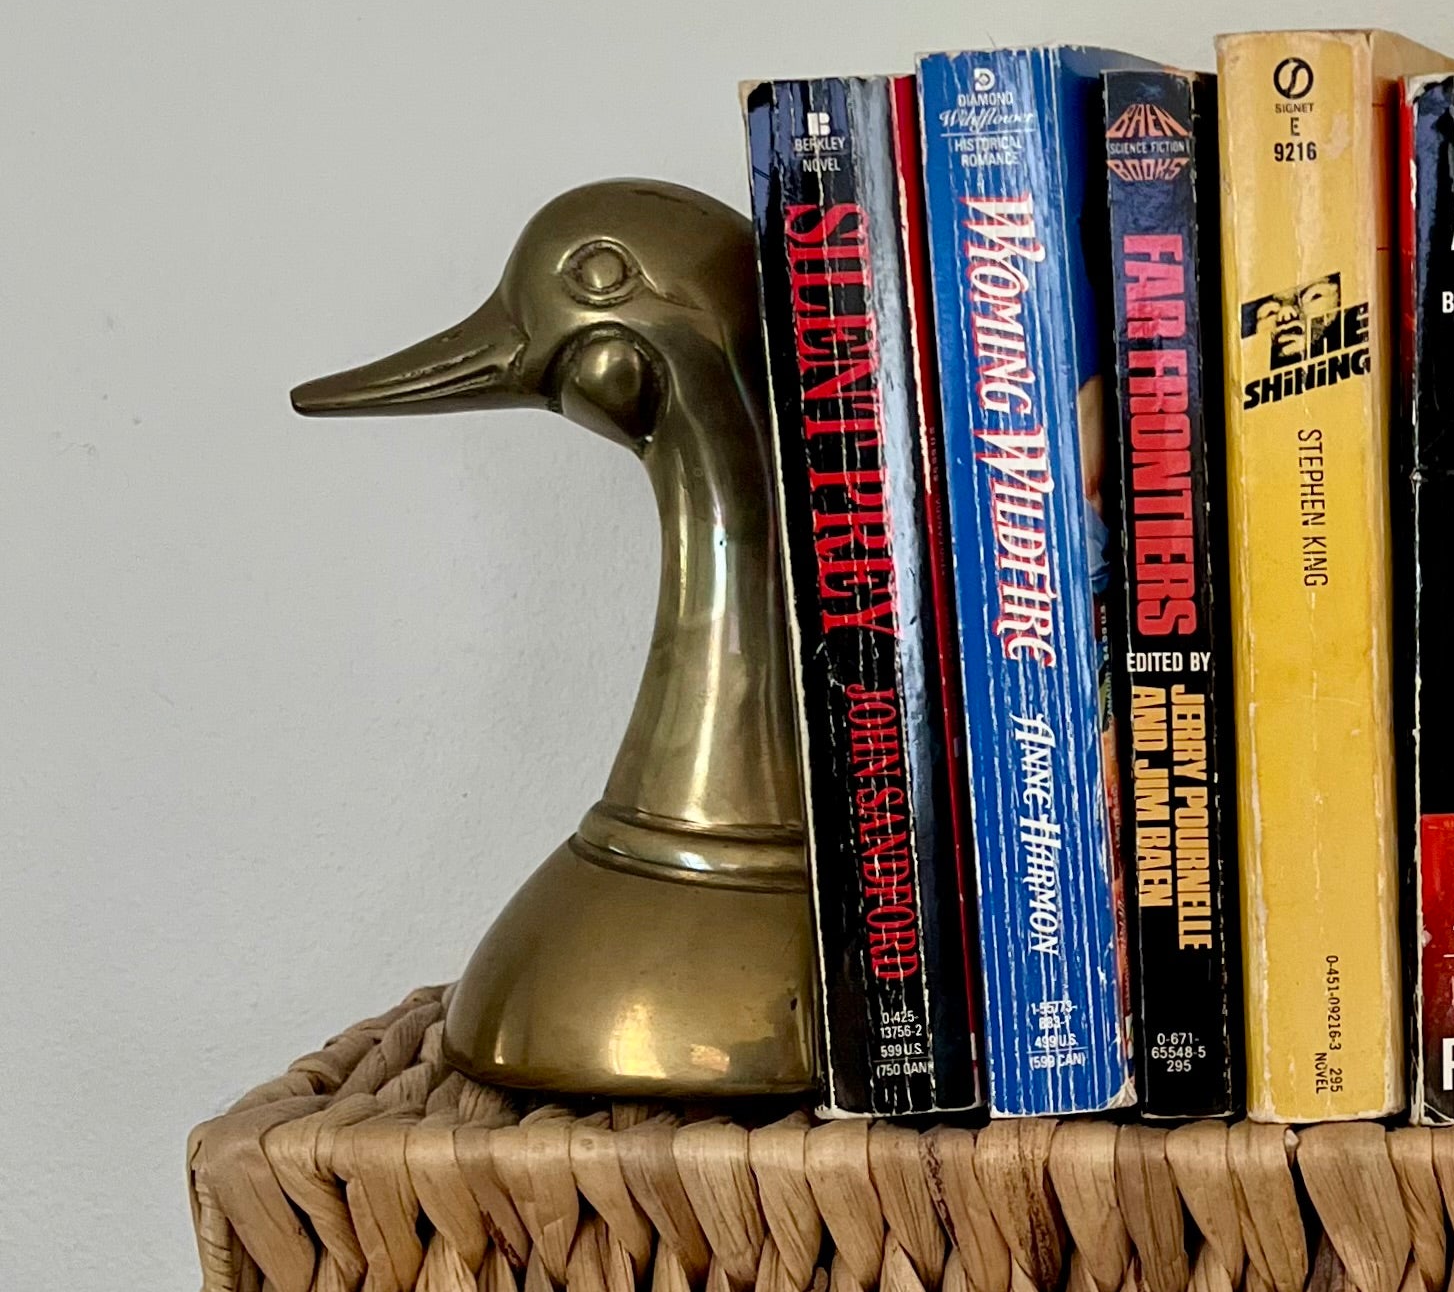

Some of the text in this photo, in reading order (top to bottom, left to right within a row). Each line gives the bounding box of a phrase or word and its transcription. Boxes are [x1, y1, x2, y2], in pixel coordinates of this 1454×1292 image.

[957, 91, 1014, 107] DIAMOND
[1275, 102, 1314, 114] SIGNET
[1105, 104, 1190, 138] BAEN
[1290, 116, 1300, 136] E
[794, 136, 846, 152] BERKLEY
[954, 135, 1023, 152] HISTORICAL
[1109, 141, 1185, 154] SCIENCE FICTION
[1274, 142, 1317, 162] 9216
[802, 157, 842, 172] NOVEL
[961, 151, 1021, 167] ROMANCE
[1105, 157, 1190, 181] BOOKS
[783, 203, 905, 640] SILENT PREY
[959, 192, 1058, 668] WYOMING WILDFIRE
[1123, 234, 1198, 638] FAR FRONTIERS
[1297, 428, 1329, 588] STEPHEN KING
[1126, 652, 1211, 672] EDITED BY
[1131, 685, 1174, 907] AND JIM BAEN
[1171, 684, 1213, 950] JERRY POURNELLE
[846, 683, 918, 980] JOHN SANDFORD
[1019, 813, 1063, 957] HARMON
[880, 1024, 922, 1039] 13756-2
[1326, 955, 1344, 1093] 0-451-09216-3 295
[1034, 1035, 1057, 1049] 499
[1156, 1032, 1200, 1046] 0-671-
[880, 1044, 902, 1058] 599
[1057, 1051, 1087, 1067] CAN)
[1151, 1046, 1206, 1059] 65548-5
[876, 1060, 933, 1079] (750 CAN
[1166, 1059, 1192, 1072] 295
[1314, 1052, 1329, 1094] NOVEL
